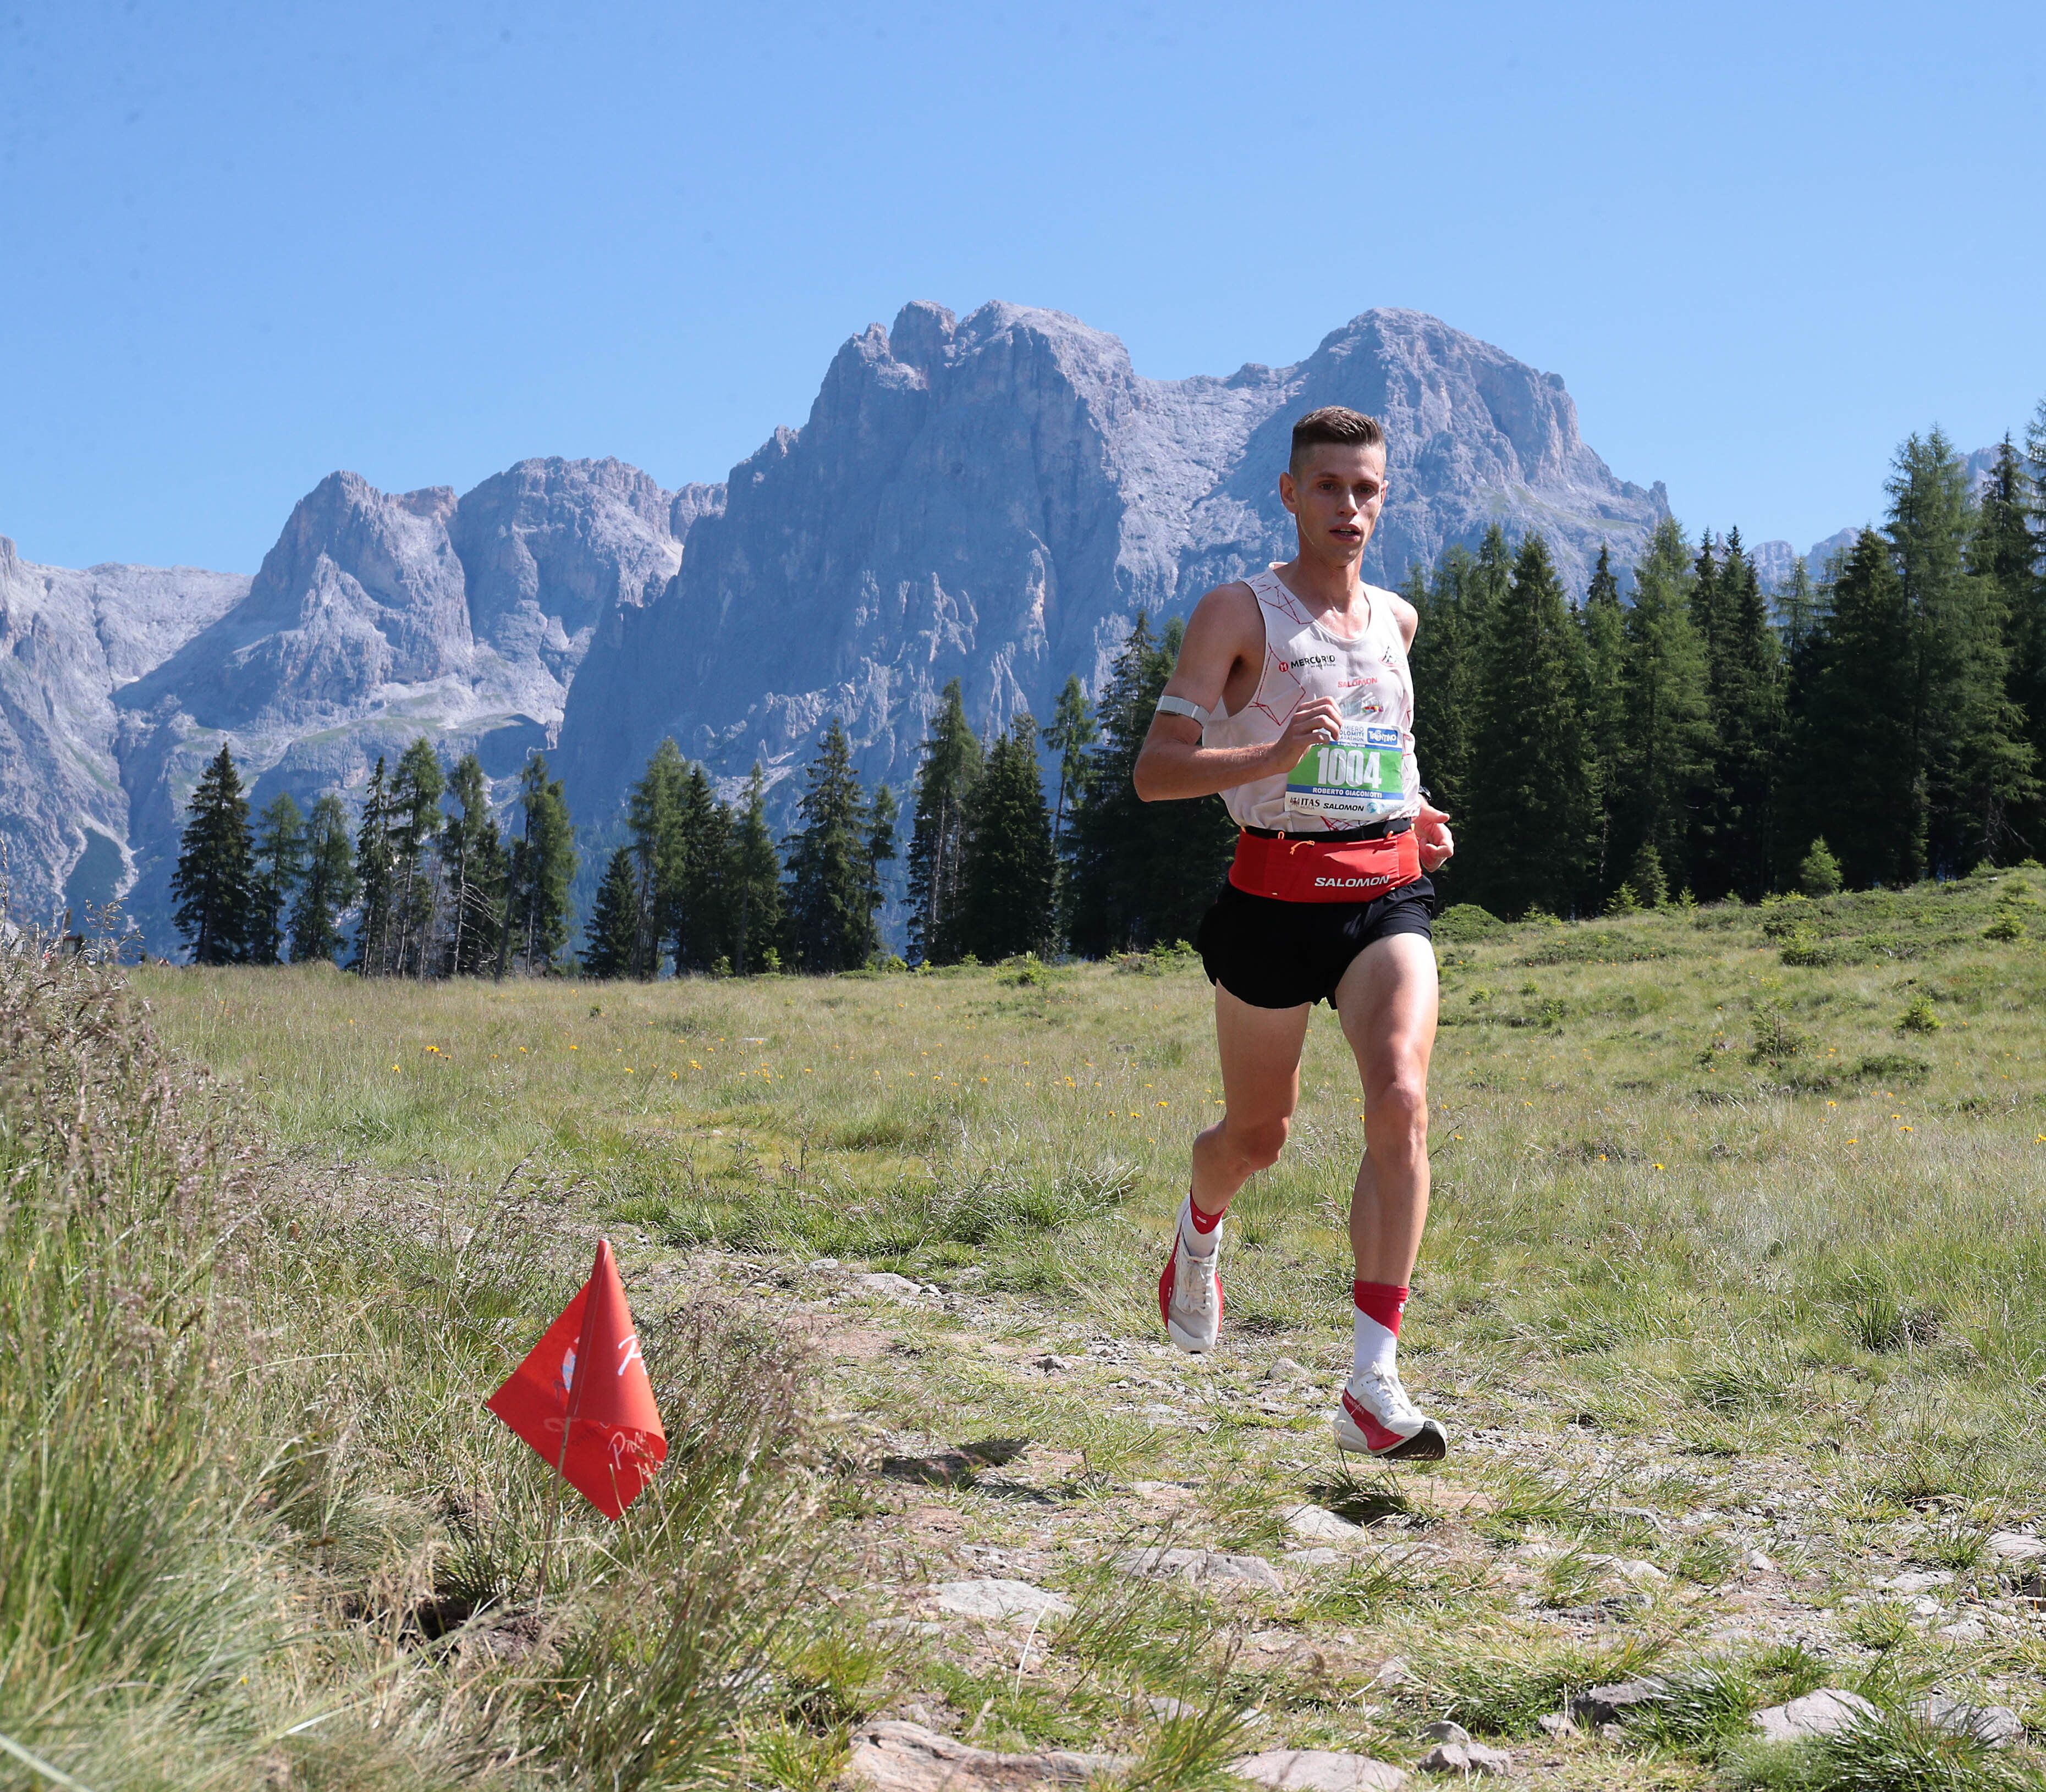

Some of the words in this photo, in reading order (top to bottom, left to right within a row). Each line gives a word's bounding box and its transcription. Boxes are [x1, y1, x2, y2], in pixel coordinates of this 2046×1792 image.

[1290, 655, 1336, 669] MERCURIO
[1338, 677, 1378, 688] SALOMON
[1317, 747, 1382, 789] 1004
[1345, 789, 1382, 798] GIACOMOTTI
[1301, 798, 1320, 807] ITAS
[1323, 803, 1364, 812] SALOMON
[1314, 874, 1390, 887] SALOMON
